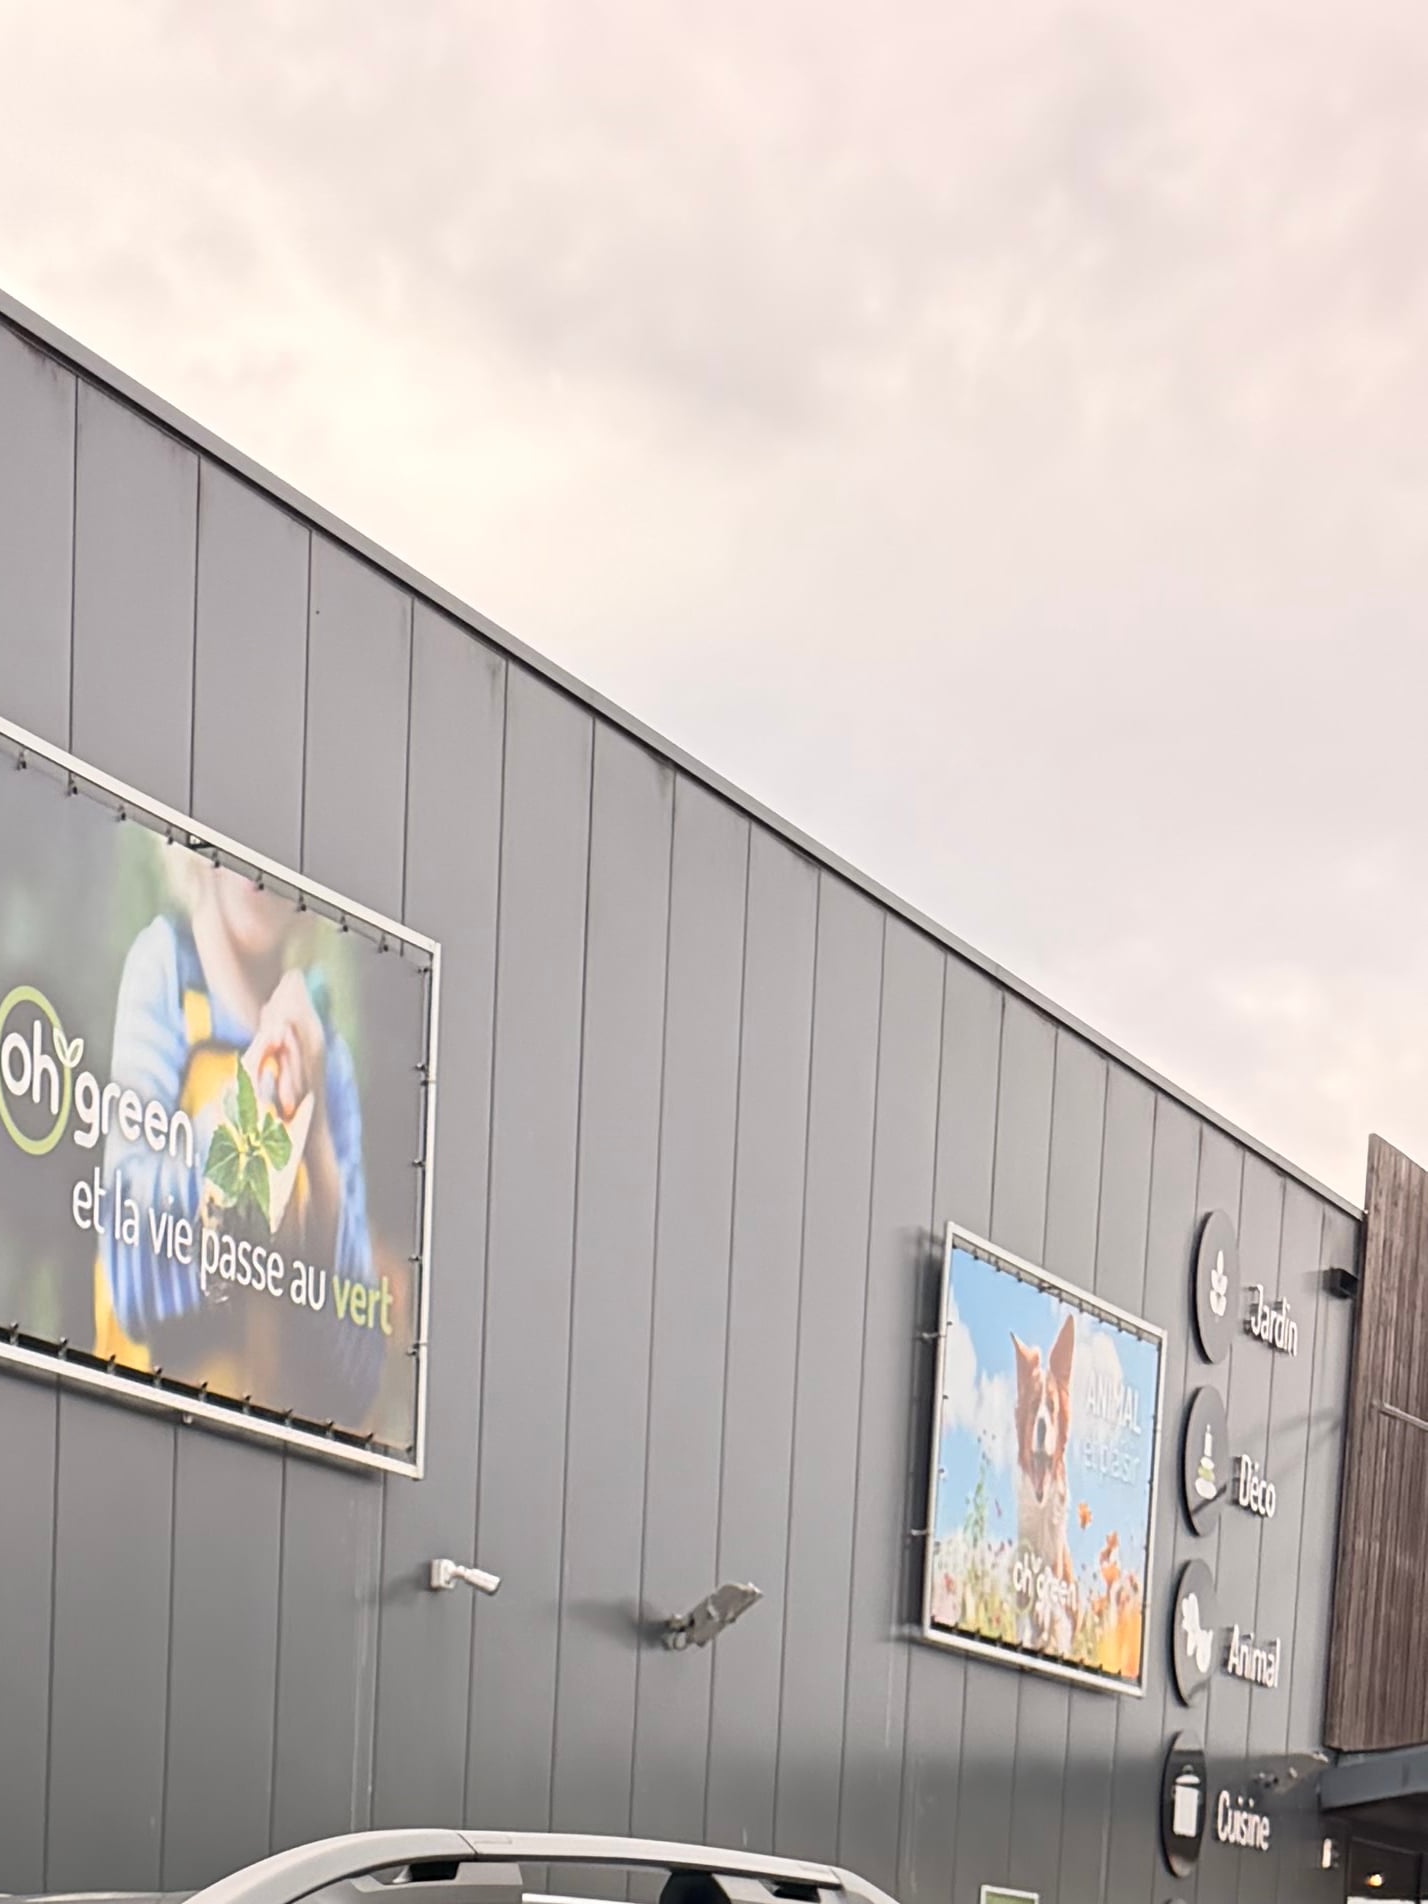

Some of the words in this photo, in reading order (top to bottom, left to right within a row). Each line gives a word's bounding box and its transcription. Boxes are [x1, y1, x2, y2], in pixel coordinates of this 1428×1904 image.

[73, 1167, 106, 1234] et
[115, 1169, 140, 1247] la
[149, 1195, 192, 1264] vie
[200, 1227, 284, 1297] passe
[290, 1260, 326, 1311] au
[332, 1274, 393, 1335] vert
[1250, 1284, 1298, 1357] Jardin
[1086, 1370, 1142, 1435] ANIMAL
[1238, 1454, 1276, 1518] Déco
[1227, 1623, 1281, 1688] Animal
[1216, 1790, 1270, 1850] Cuisine
